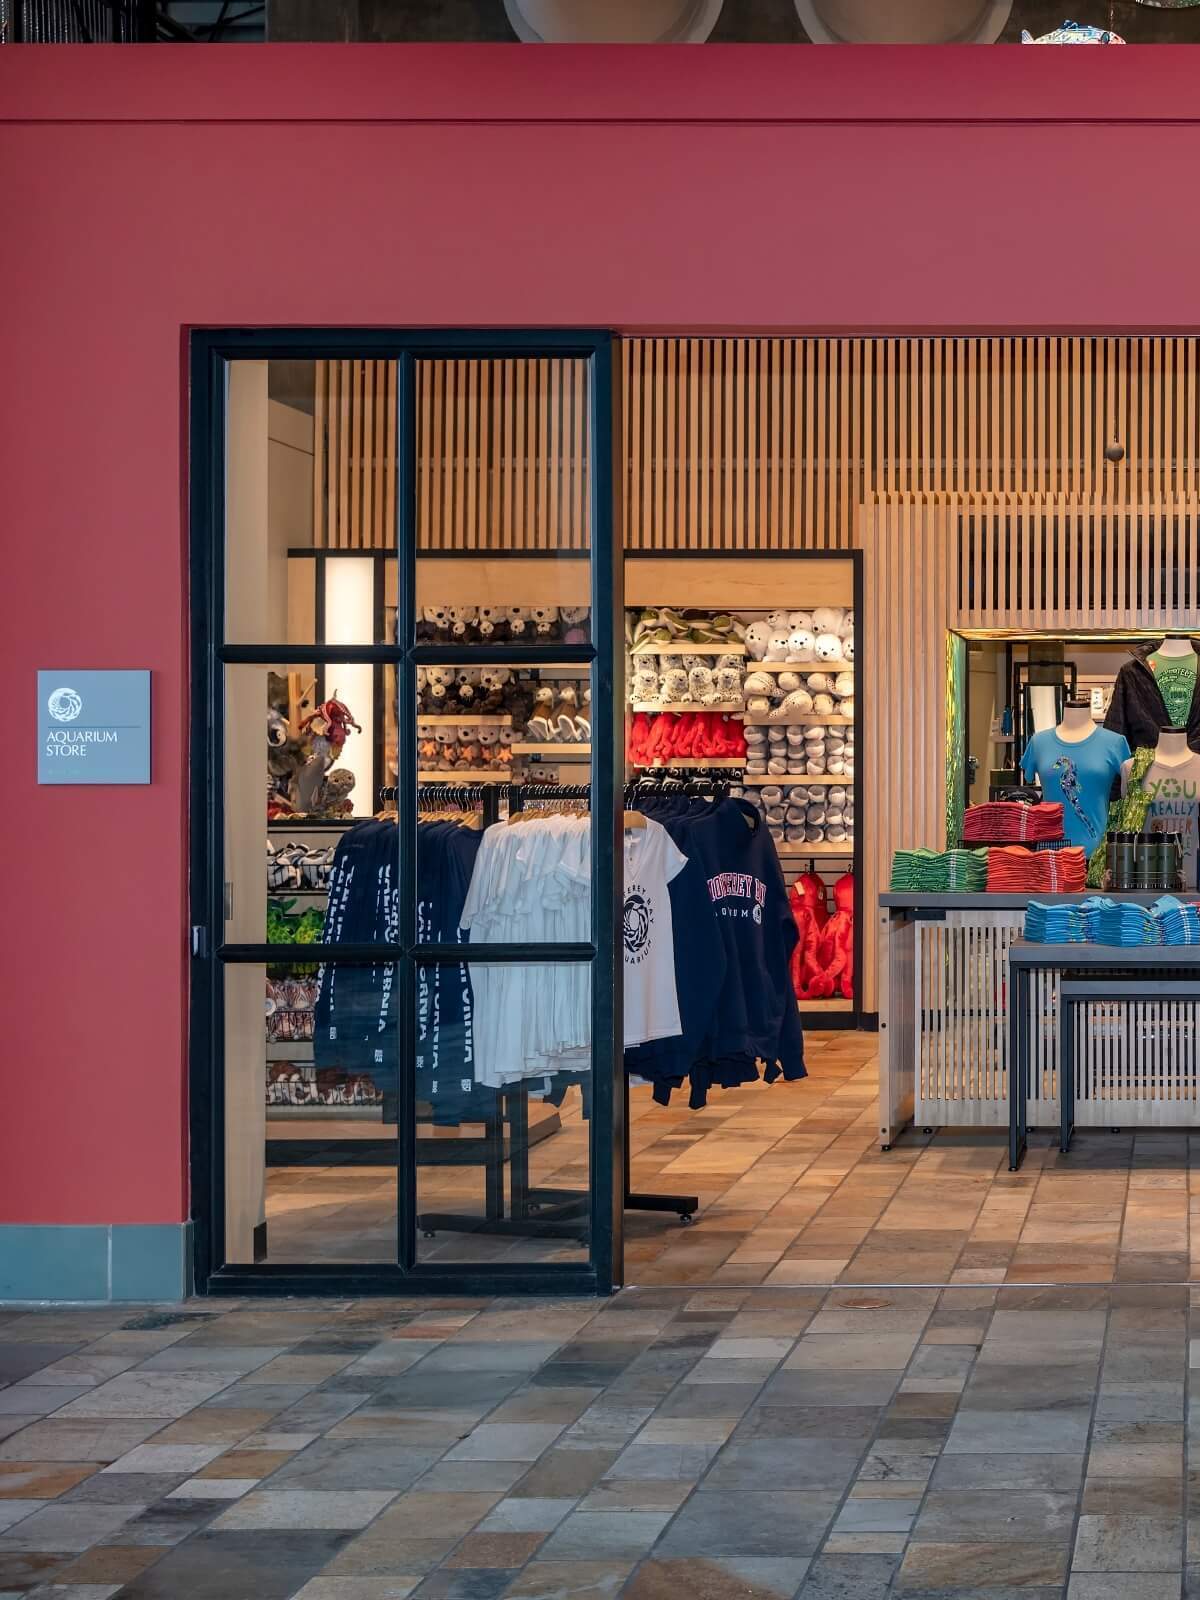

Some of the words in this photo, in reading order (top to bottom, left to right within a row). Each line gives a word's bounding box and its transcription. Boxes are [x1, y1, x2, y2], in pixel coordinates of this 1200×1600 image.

[47, 731, 118, 744] AQUARIUM
[46, 744, 87, 757] STORE
[1151, 801, 1195, 817] REALLY
